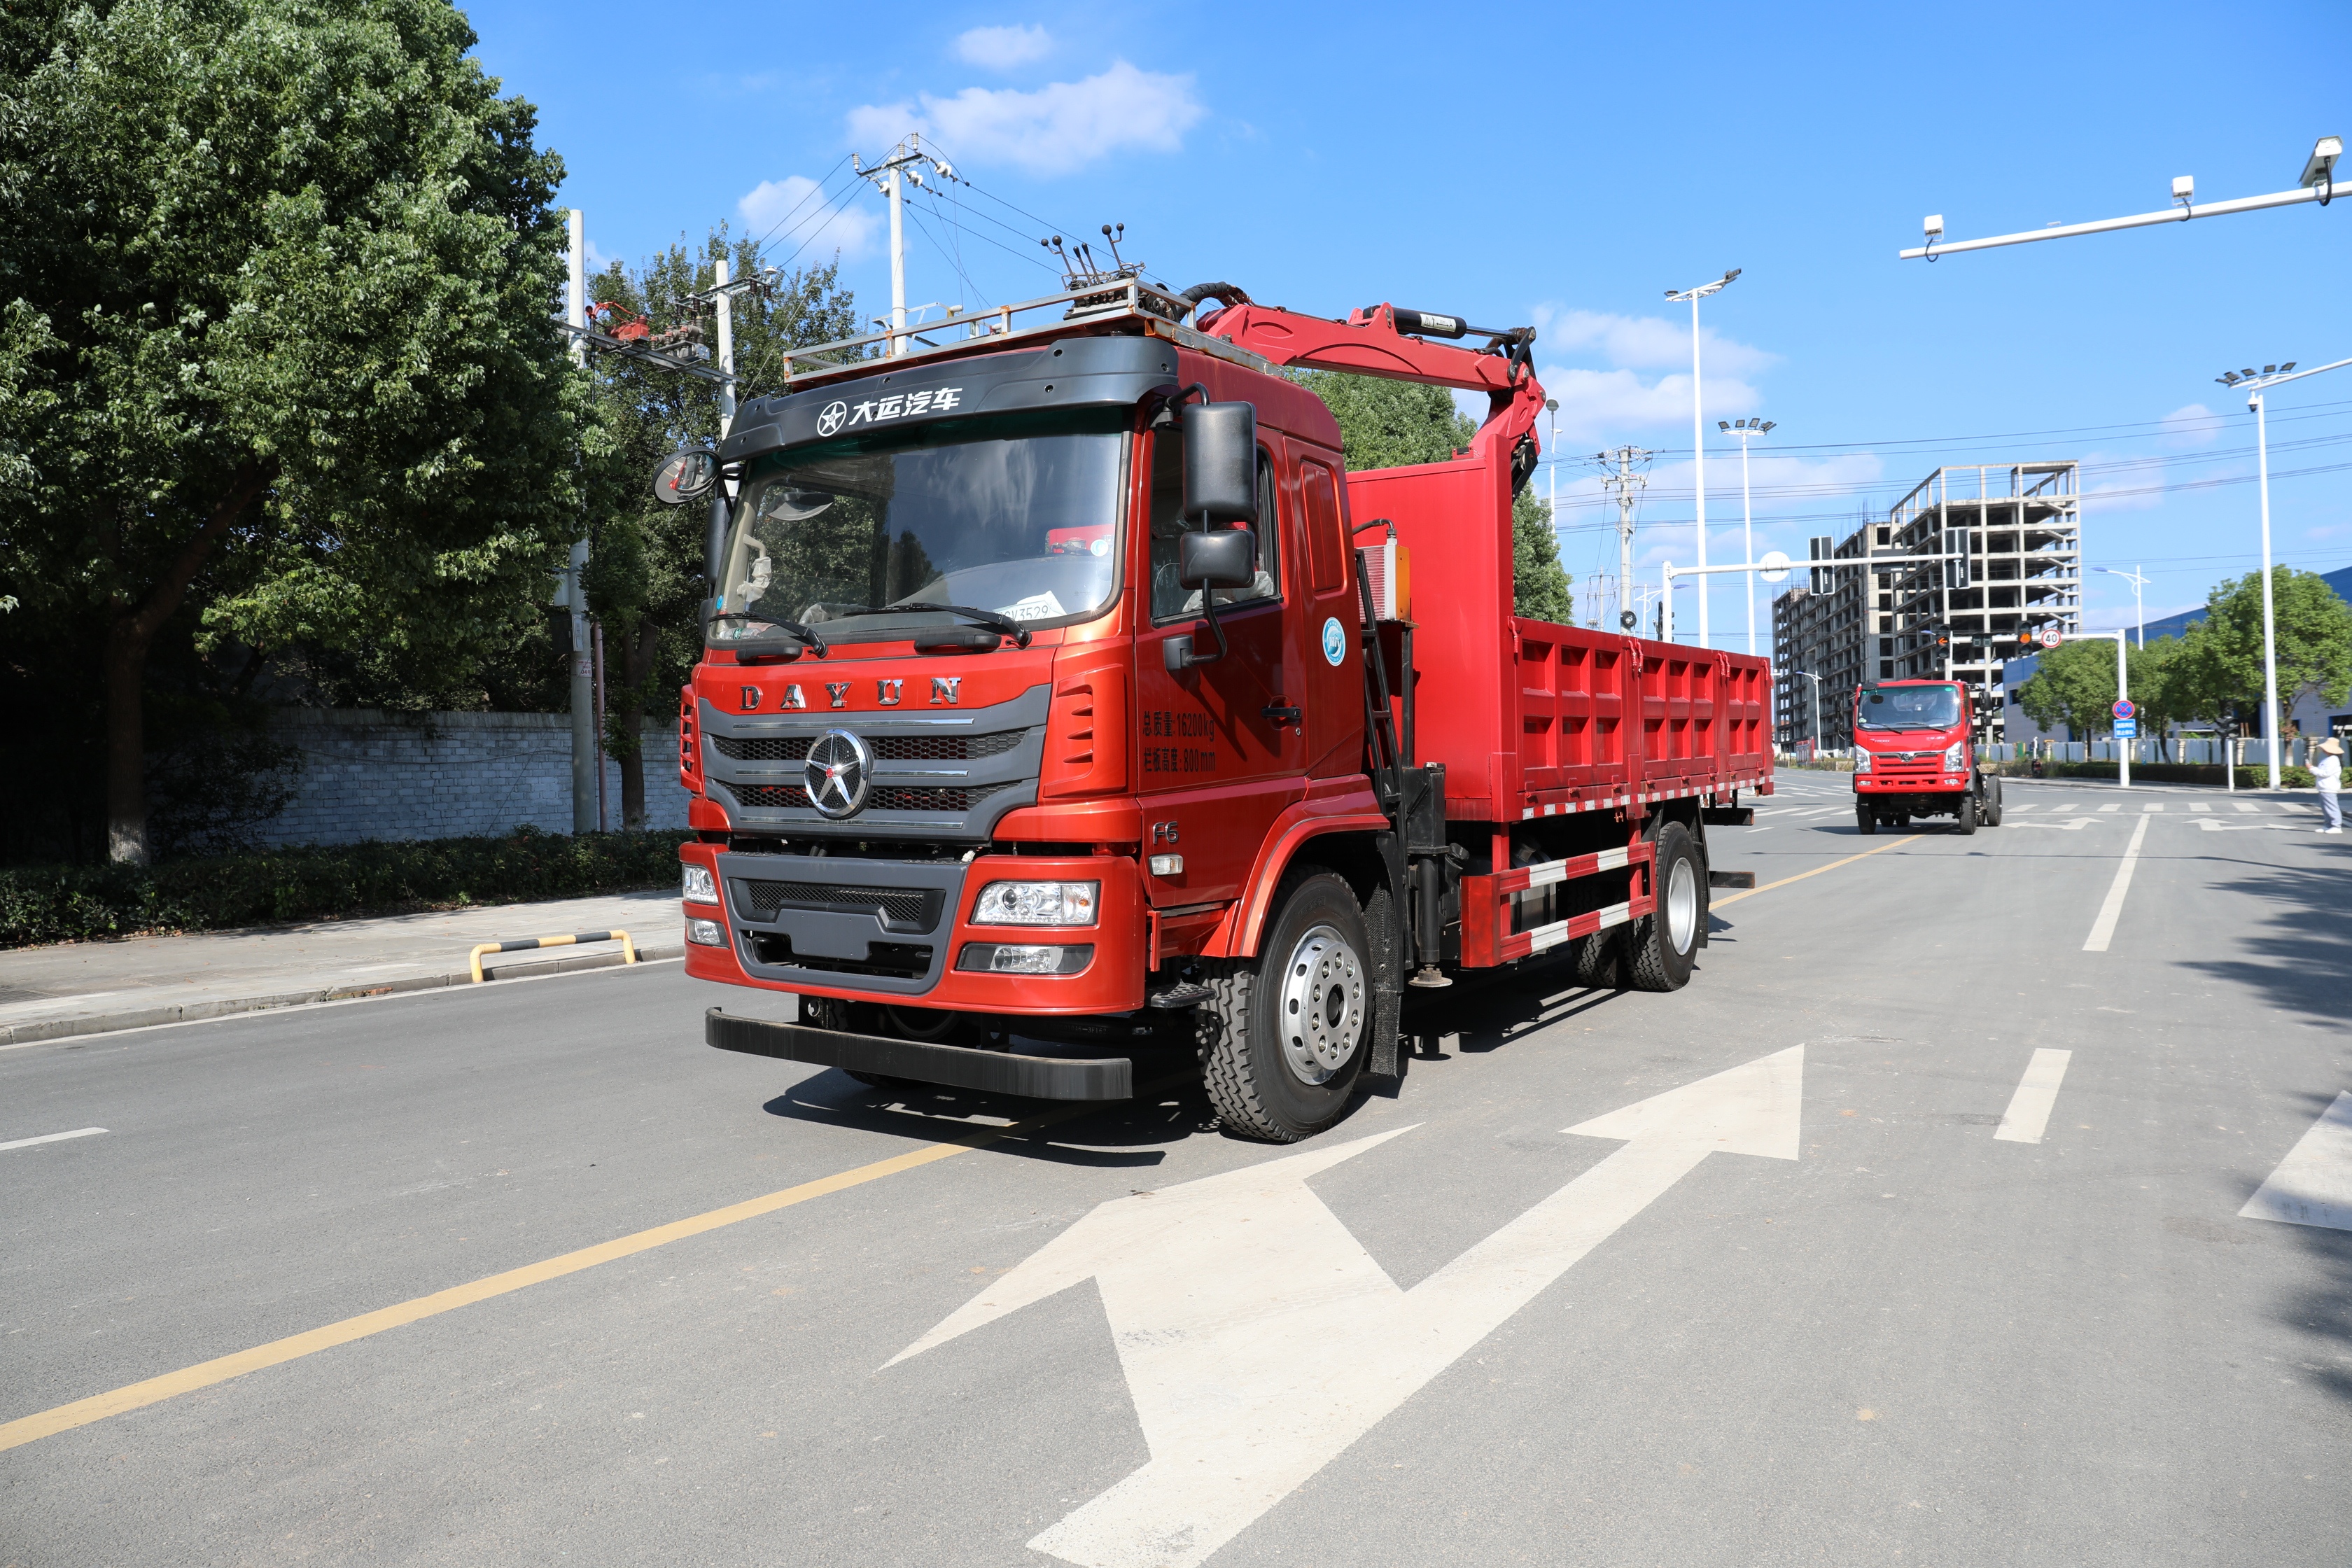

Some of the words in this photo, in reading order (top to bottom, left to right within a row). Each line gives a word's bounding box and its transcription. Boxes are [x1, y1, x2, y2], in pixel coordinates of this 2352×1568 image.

[848, 387, 963, 426] 大运汽车
[2045, 634, 2057, 643] 40
[739, 678, 962, 710] DAYUN
[1152, 821, 1179, 844] F6
